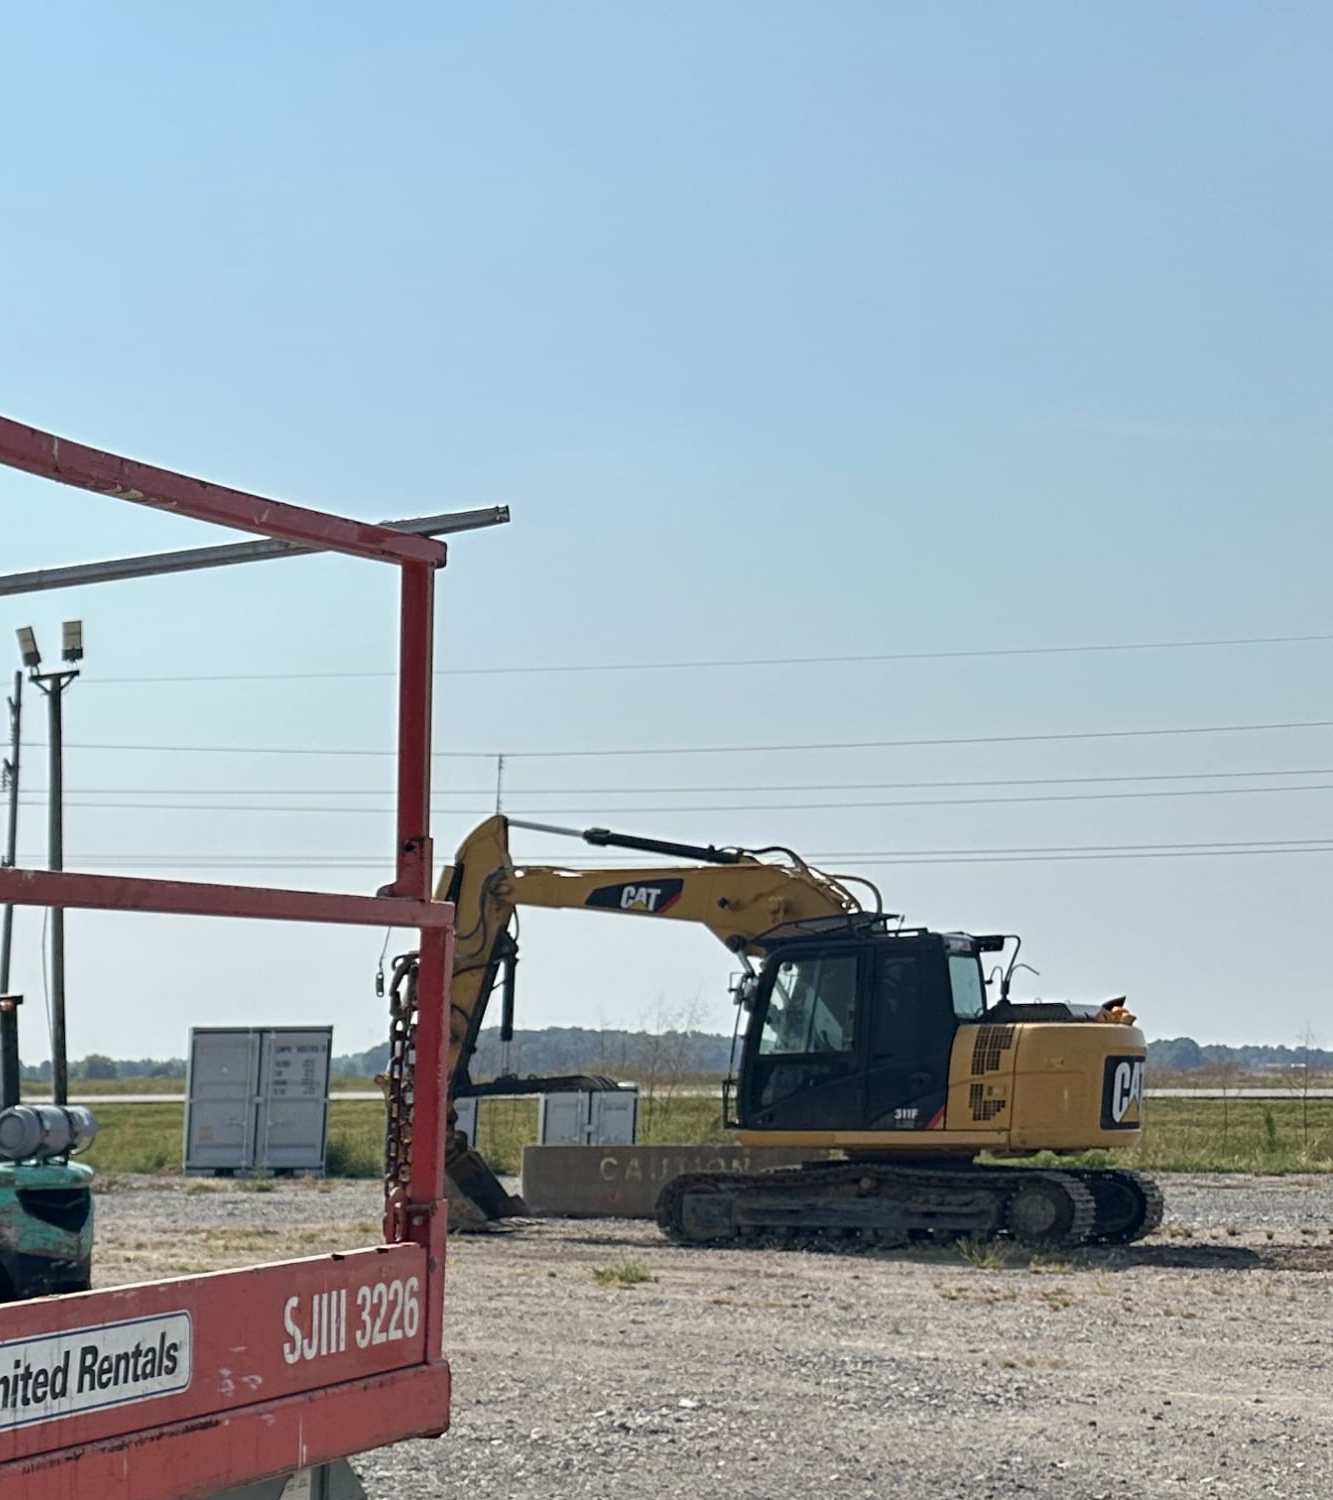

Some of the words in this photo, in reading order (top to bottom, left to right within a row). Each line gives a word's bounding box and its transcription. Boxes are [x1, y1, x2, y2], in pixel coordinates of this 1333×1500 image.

[620, 886, 661, 912] CAT
[894, 1108, 919, 1120] 311F
[1112, 1062, 1145, 1123] CA
[355, 1276, 419, 1349] 3226
[77, 1332, 178, 1393] Rentals
